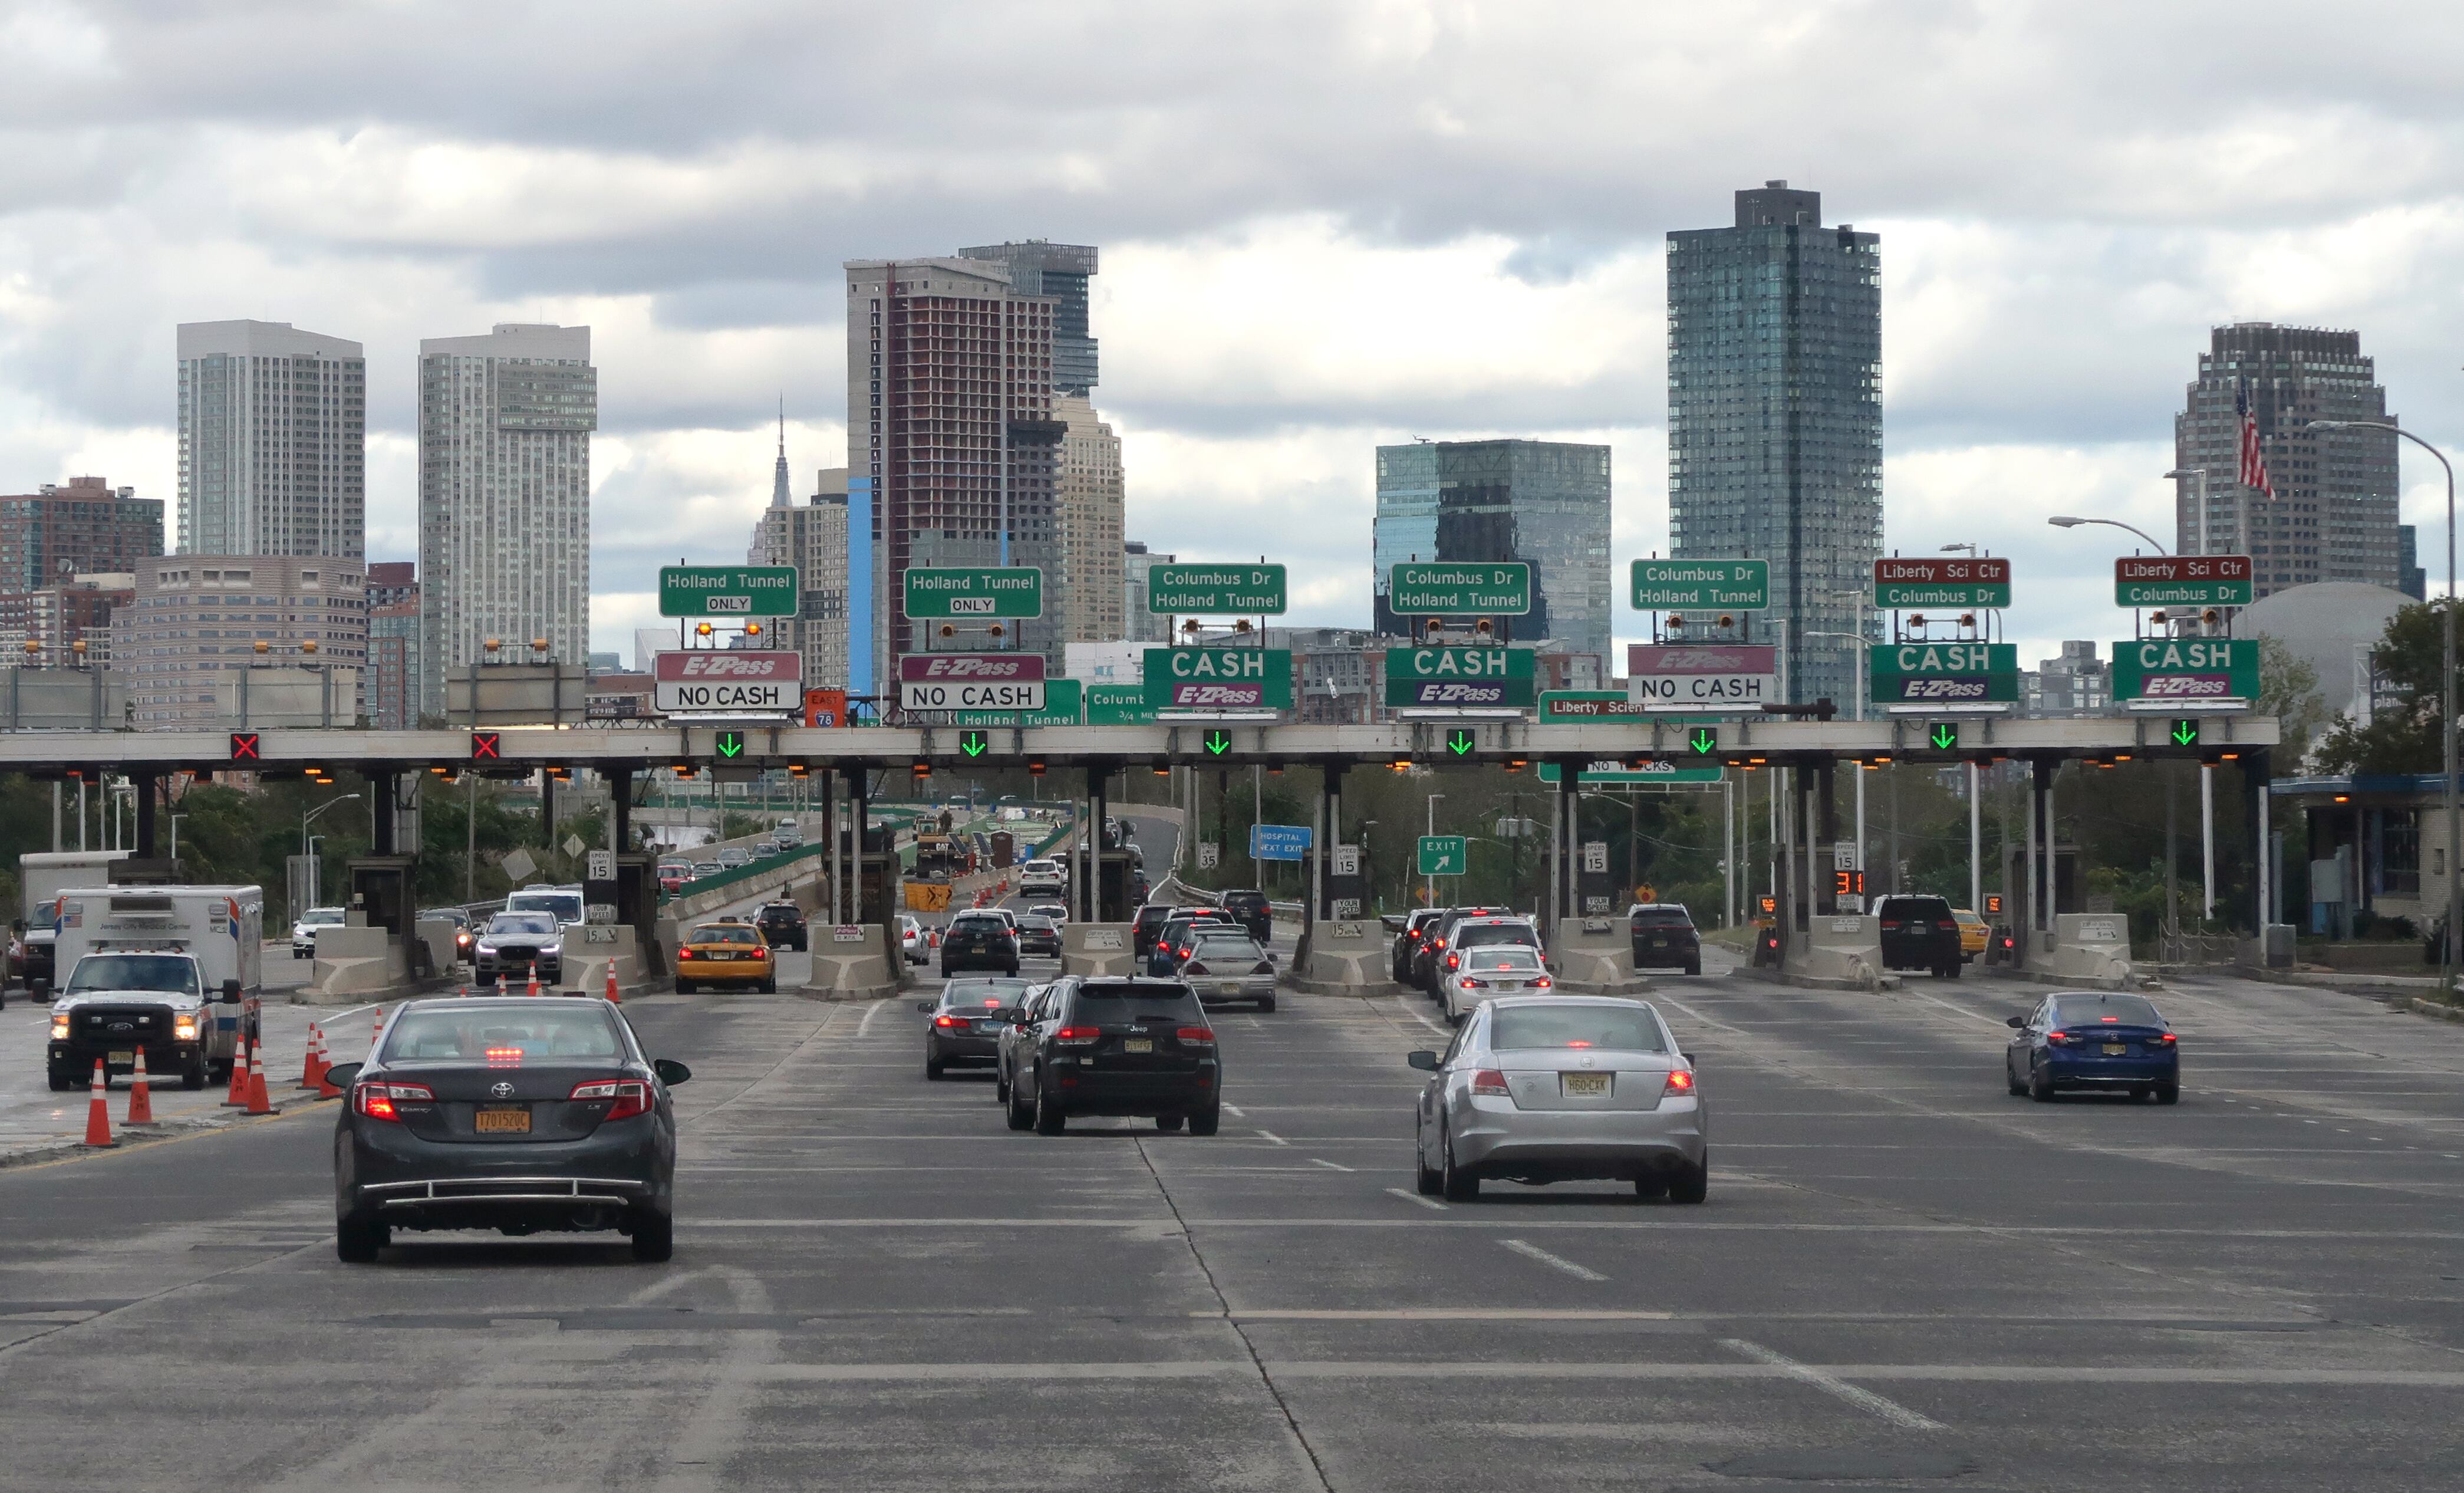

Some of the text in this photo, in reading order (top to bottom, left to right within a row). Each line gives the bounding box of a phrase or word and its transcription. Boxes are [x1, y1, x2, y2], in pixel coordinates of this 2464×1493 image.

[1646, 567, 1754, 581] Columbus Dr
[1883, 564, 2001, 581] Liberty Sci Ctr
[2125, 561, 2242, 579] Liberty Sci Ctr
[667, 574, 789, 588] Holland Tunnel
[913, 576, 1034, 590] Holland Tunnel
[1163, 571, 1271, 586] Columbus Dr
[1406, 570, 1514, 585] Columbus Dr
[1156, 593, 1279, 608] Holland Tunnel
[1399, 593, 1521, 607] Holland Tunnel
[1639, 589, 1761, 603] Holland Tunnel
[1889, 589, 1995, 603] Columbus Dr
[2130, 586, 2238, 601] Columbus Dr
[709, 598, 749, 610] ONLY
[953, 600, 993, 611] ONLY
[1415, 650, 1507, 675] CASH
[1898, 646, 1989, 671] CASH
[2139, 643, 2231, 669] CASH
[682, 656, 775, 675] E-ZPass
[926, 659, 1019, 676] E-ZPass
[1171, 652, 1264, 677] CASH
[1419, 684, 1501, 702] E-ZPass
[1642, 679, 1761, 698] NO CASH
[1904, 680, 1985, 698] E-ZPass
[2146, 677, 2226, 695] E-ZPass
[678, 686, 779, 706] NO CASH
[812, 696, 838, 705] EAST
[913, 687, 1032, 706] NO CASH
[1177, 686, 1259, 704] E-ZPass
[1554, 701, 1643, 715] Liberty Scien
[819, 715, 832, 725] 78
[1026, 714, 1074, 725] Tunnel
[1592, 761, 1670, 771] NO TCKS
[1260, 832, 1302, 841] HOSPITAL
[935, 843, 950, 851] CAT
[1284, 844, 1304, 853] EXIT
[1427, 841, 1457, 851] EXIT
[1201, 855, 1215, 866] 35
[1340, 861, 1355, 872] 15
[1589, 859, 1603, 869] 15
[1838, 857, 1853, 868] 15
[592, 866, 607, 877] 15
[1836, 872, 1863, 895] 31
[1333, 924, 1344, 935] 15
[1129, 1025, 1148, 1033] Jeep
